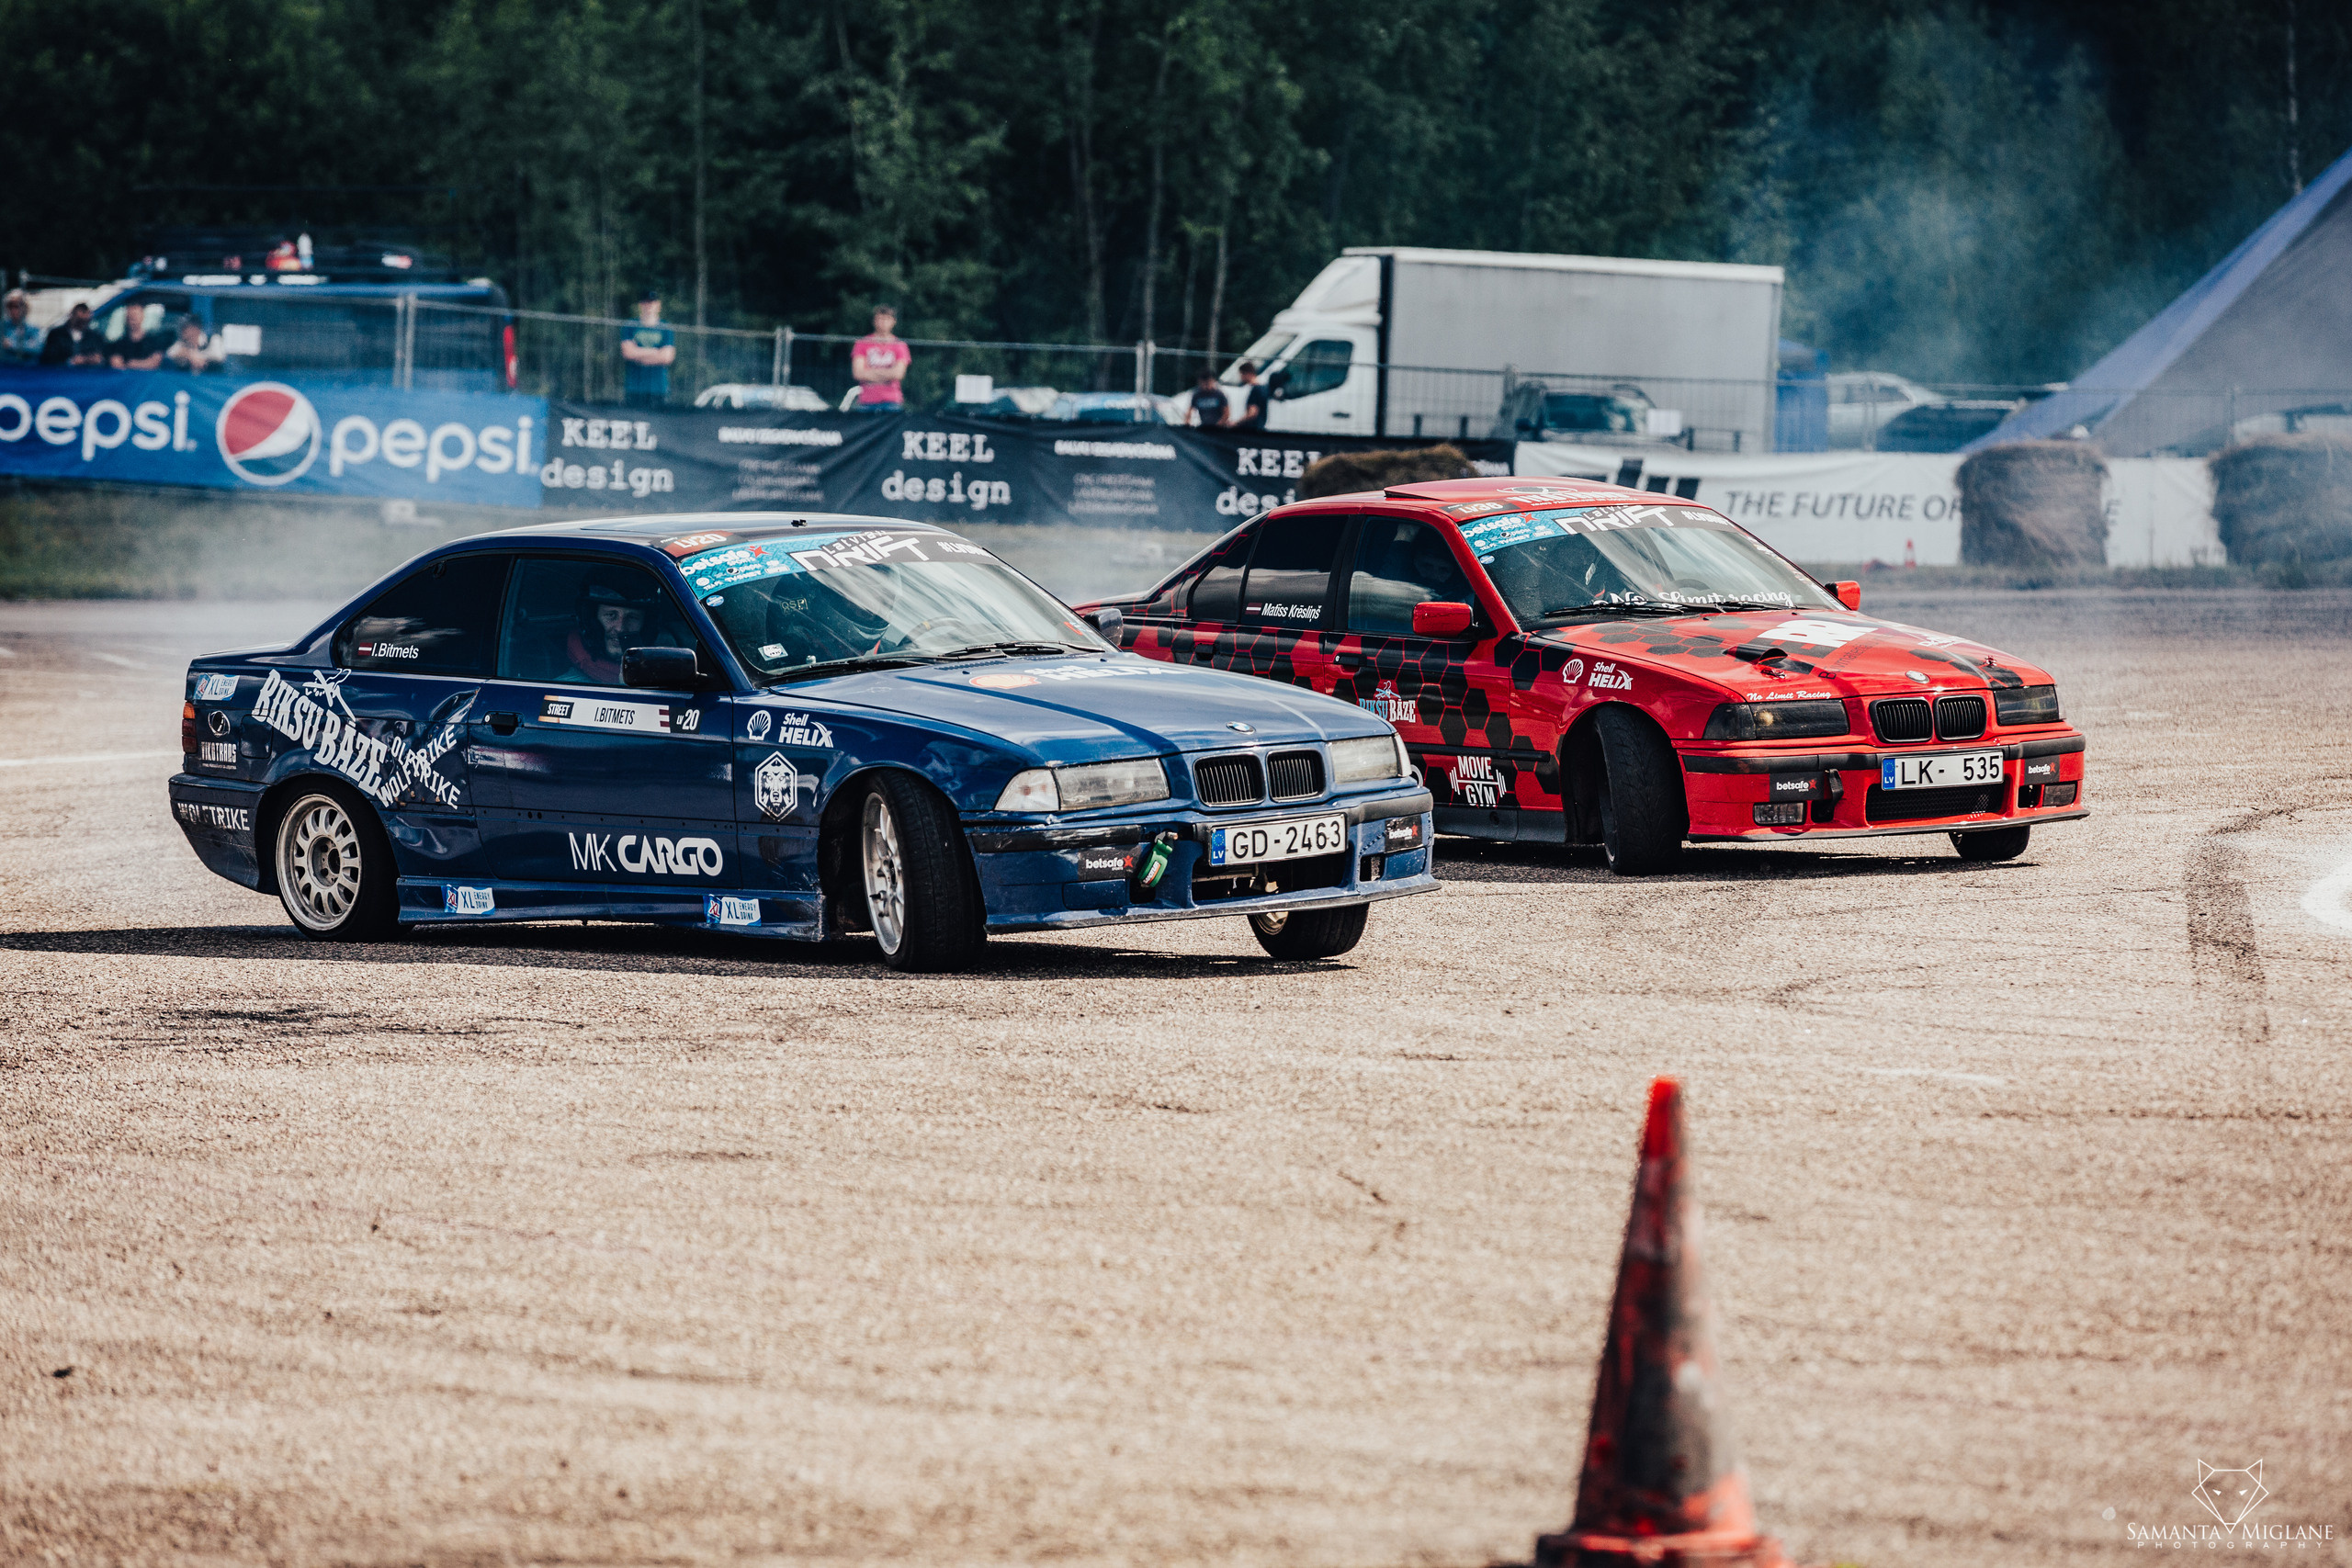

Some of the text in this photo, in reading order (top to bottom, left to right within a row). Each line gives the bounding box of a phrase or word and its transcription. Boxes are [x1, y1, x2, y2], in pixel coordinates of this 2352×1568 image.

[561, 418, 658, 451] KEEL
[329, 415, 534, 483] pepsi
[901, 431, 995, 463] KEEL
[540, 457, 675, 498] design
[881, 469, 1012, 511] design
[1216, 486, 1295, 516] desi
[1727, 491, 1783, 517] THE
[1792, 492, 1916, 521] FUTURE
[673, 533, 728, 549] LV20
[371, 642, 419, 660] I.Bitmets
[1593, 661, 1616, 673] Shell
[208, 679, 220, 696] XL
[1588, 670, 1634, 691] HELIX
[1766, 691, 1794, 700] Limit
[1796, 690, 1831, 699] Racing
[547, 703, 571, 716] STREET
[594, 706, 635, 725] I.BITMETS
[682, 709, 700, 731] 20
[783, 713, 808, 727] Shell
[778, 722, 834, 749] HELIX
[1457, 755, 1494, 779] MOVE
[1465, 783, 1496, 807] GYM
[1776, 780, 1809, 791] betsafe
[569, 832, 724, 877] MK CARGO
[1085, 856, 1125, 869] betsafe
[1213, 850, 1224, 860] LV
[461, 890, 475, 908] XL
[725, 901, 756, 919] XL ENERGY
